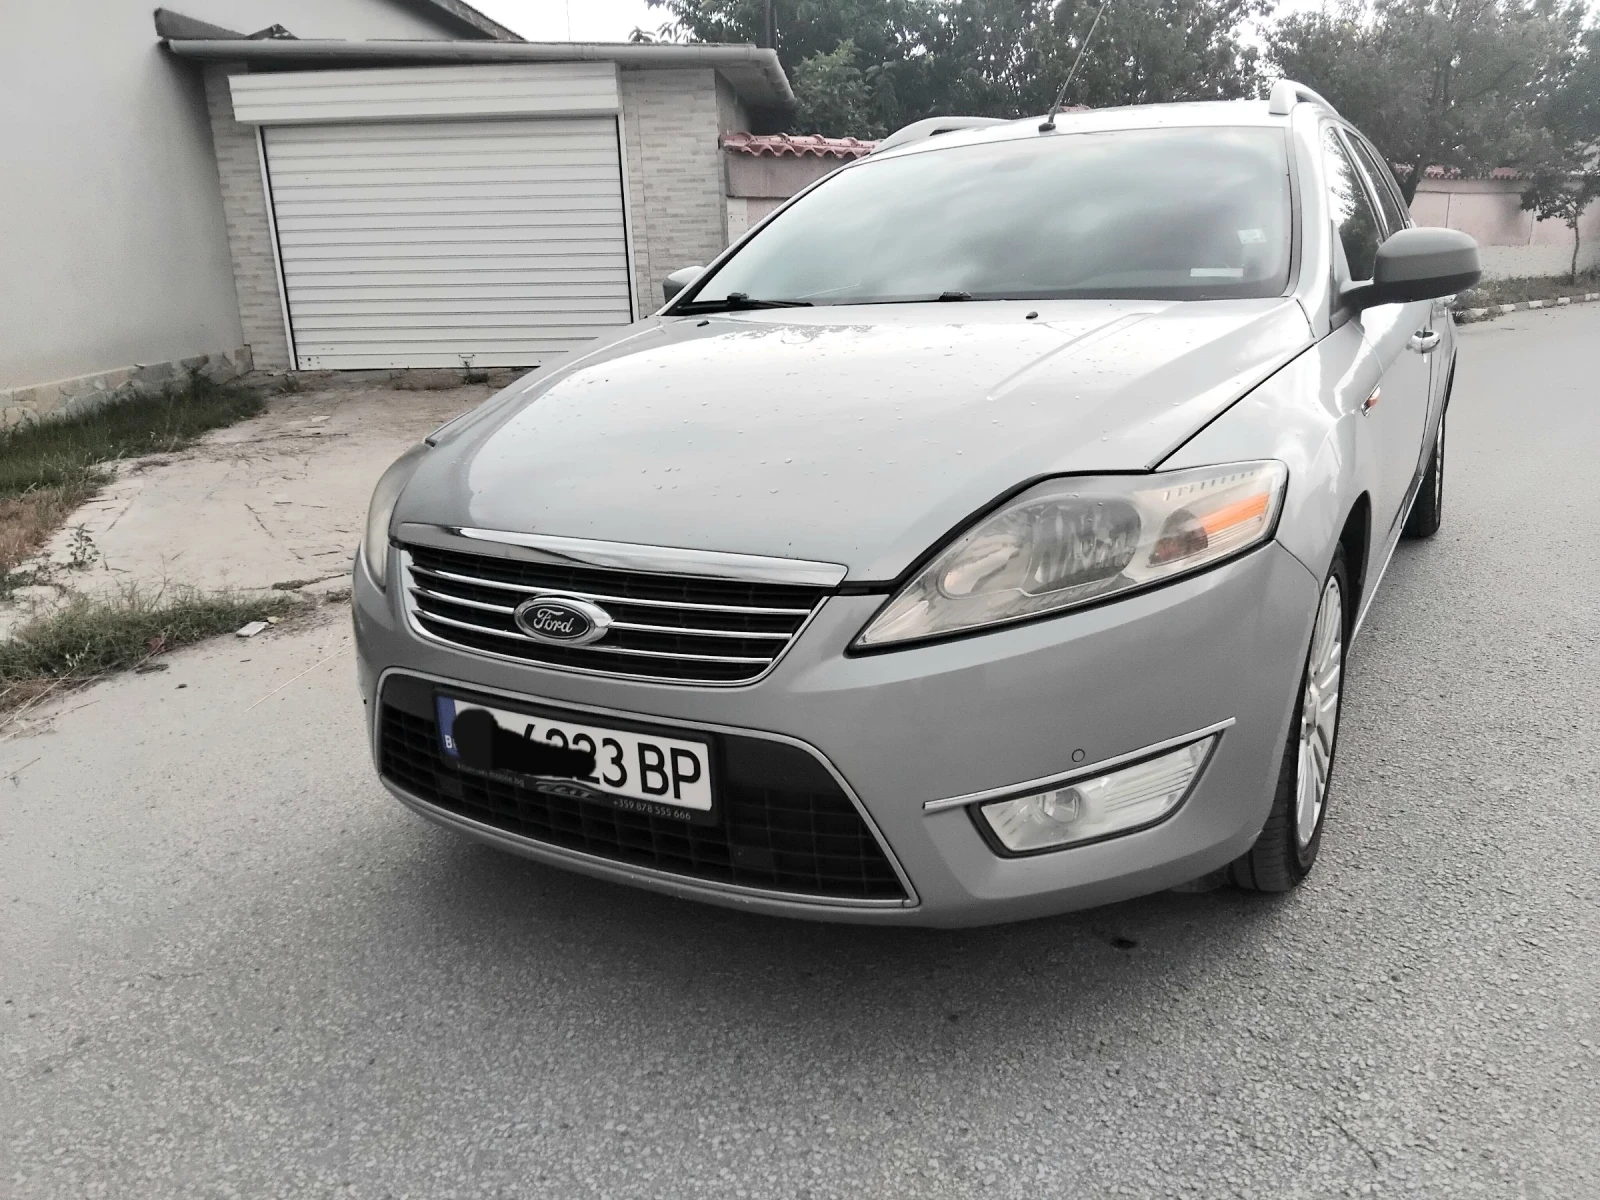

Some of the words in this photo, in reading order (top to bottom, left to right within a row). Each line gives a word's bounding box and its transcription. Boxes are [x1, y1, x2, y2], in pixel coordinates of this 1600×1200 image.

[534, 608, 574, 633] Ford
[638, 742, 701, 799] BP
[613, 799, 635, 809] +359
[655, 806, 672, 817] 555
[673, 809, 691, 820] 666
